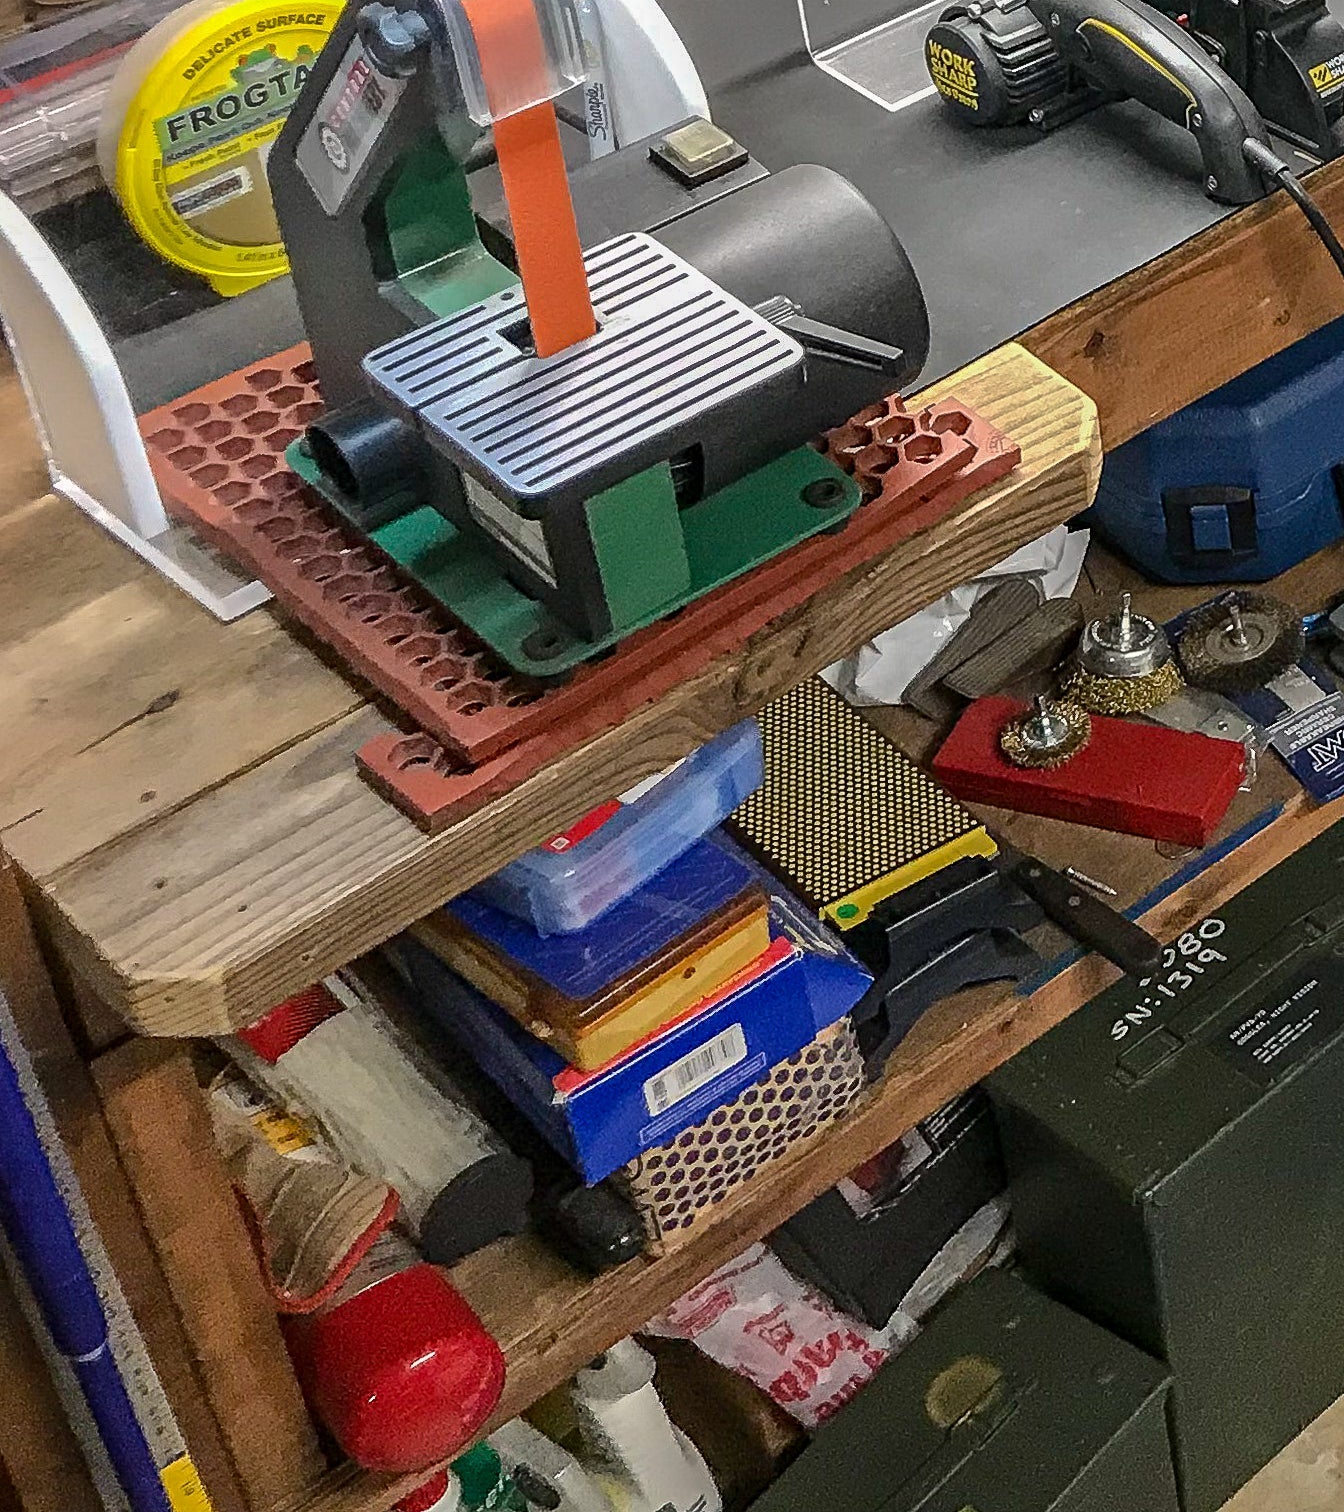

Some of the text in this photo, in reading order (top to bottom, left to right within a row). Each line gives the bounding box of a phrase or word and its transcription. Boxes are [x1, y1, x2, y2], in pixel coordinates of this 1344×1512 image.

[182, 13, 327, 81] DELICATE SURFACE
[929, 39, 976, 77] WORK
[930, 57, 977, 91] SHARP
[587, 83, 608, 140] Sharpie
